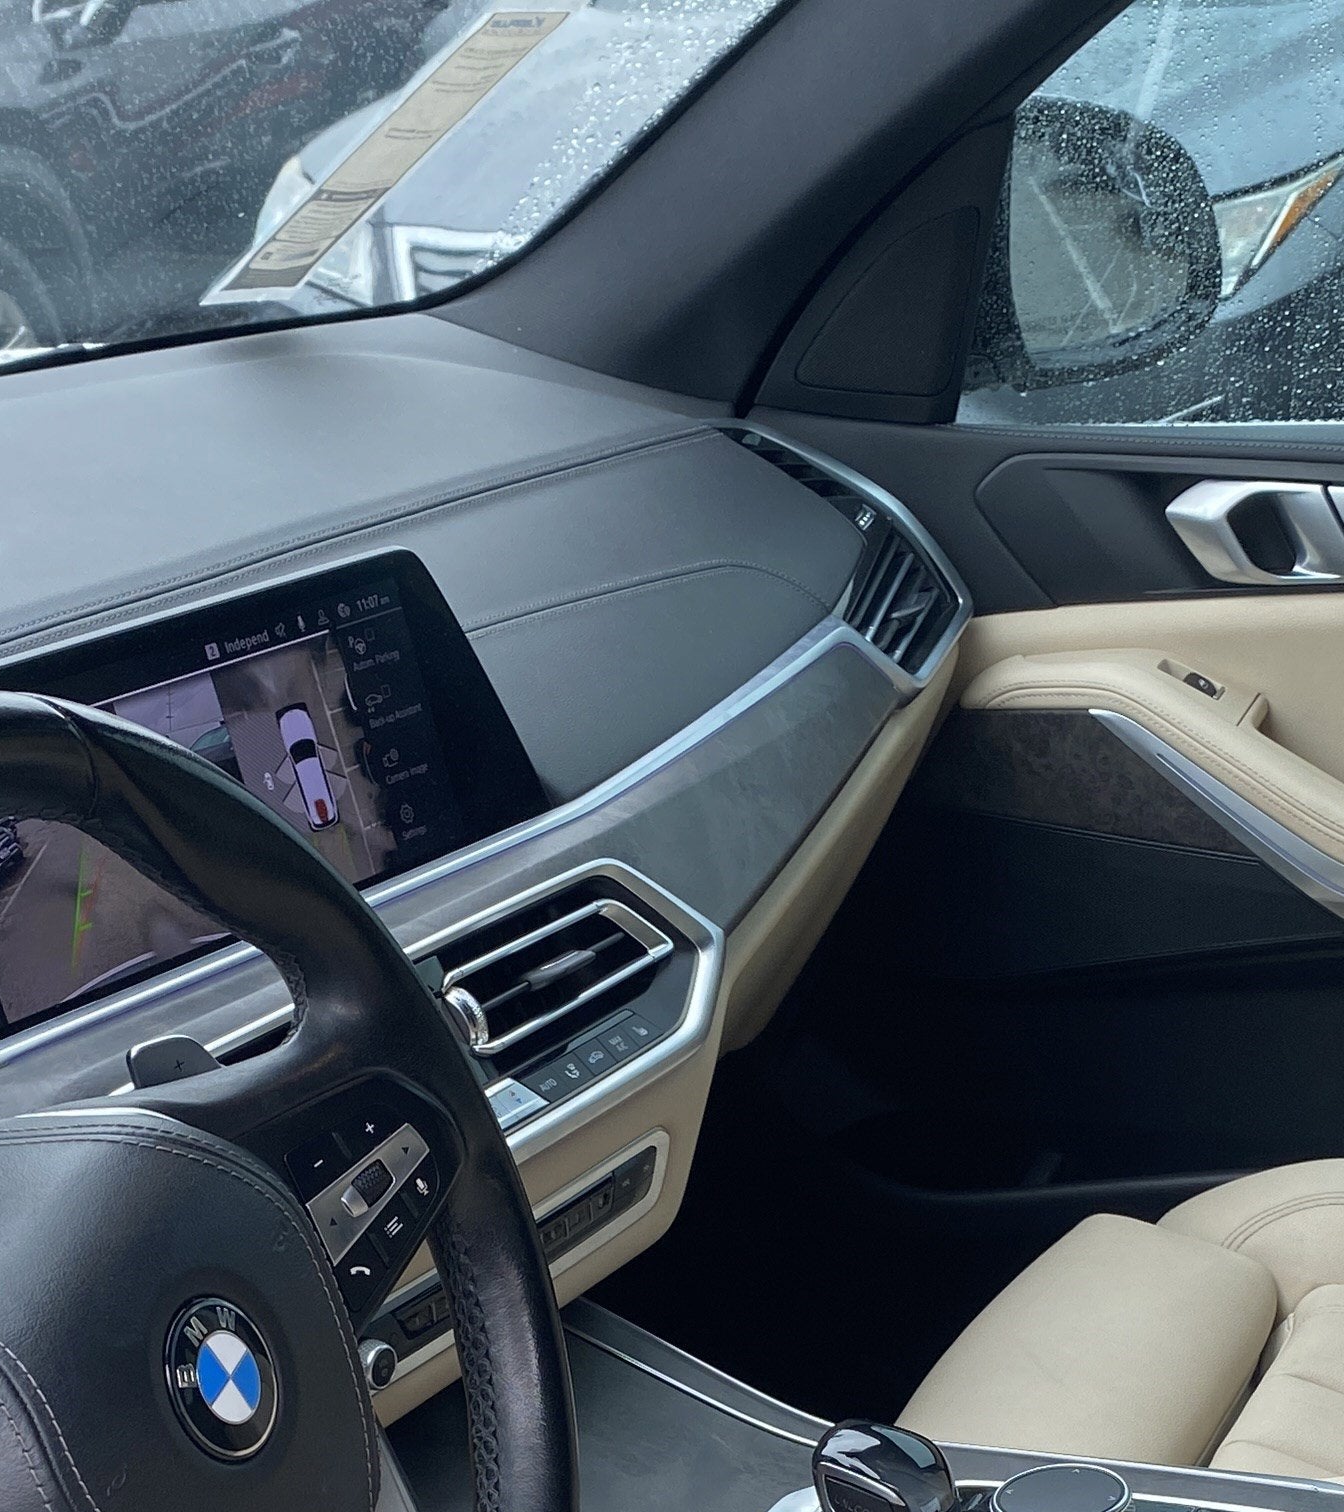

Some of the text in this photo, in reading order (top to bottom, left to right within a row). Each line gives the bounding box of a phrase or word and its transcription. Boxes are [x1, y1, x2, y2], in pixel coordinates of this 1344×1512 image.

[225, 630, 269, 654] Independ
[539, 1078, 557, 1092] AUTO
[176, 1306, 236, 1388] BMW
